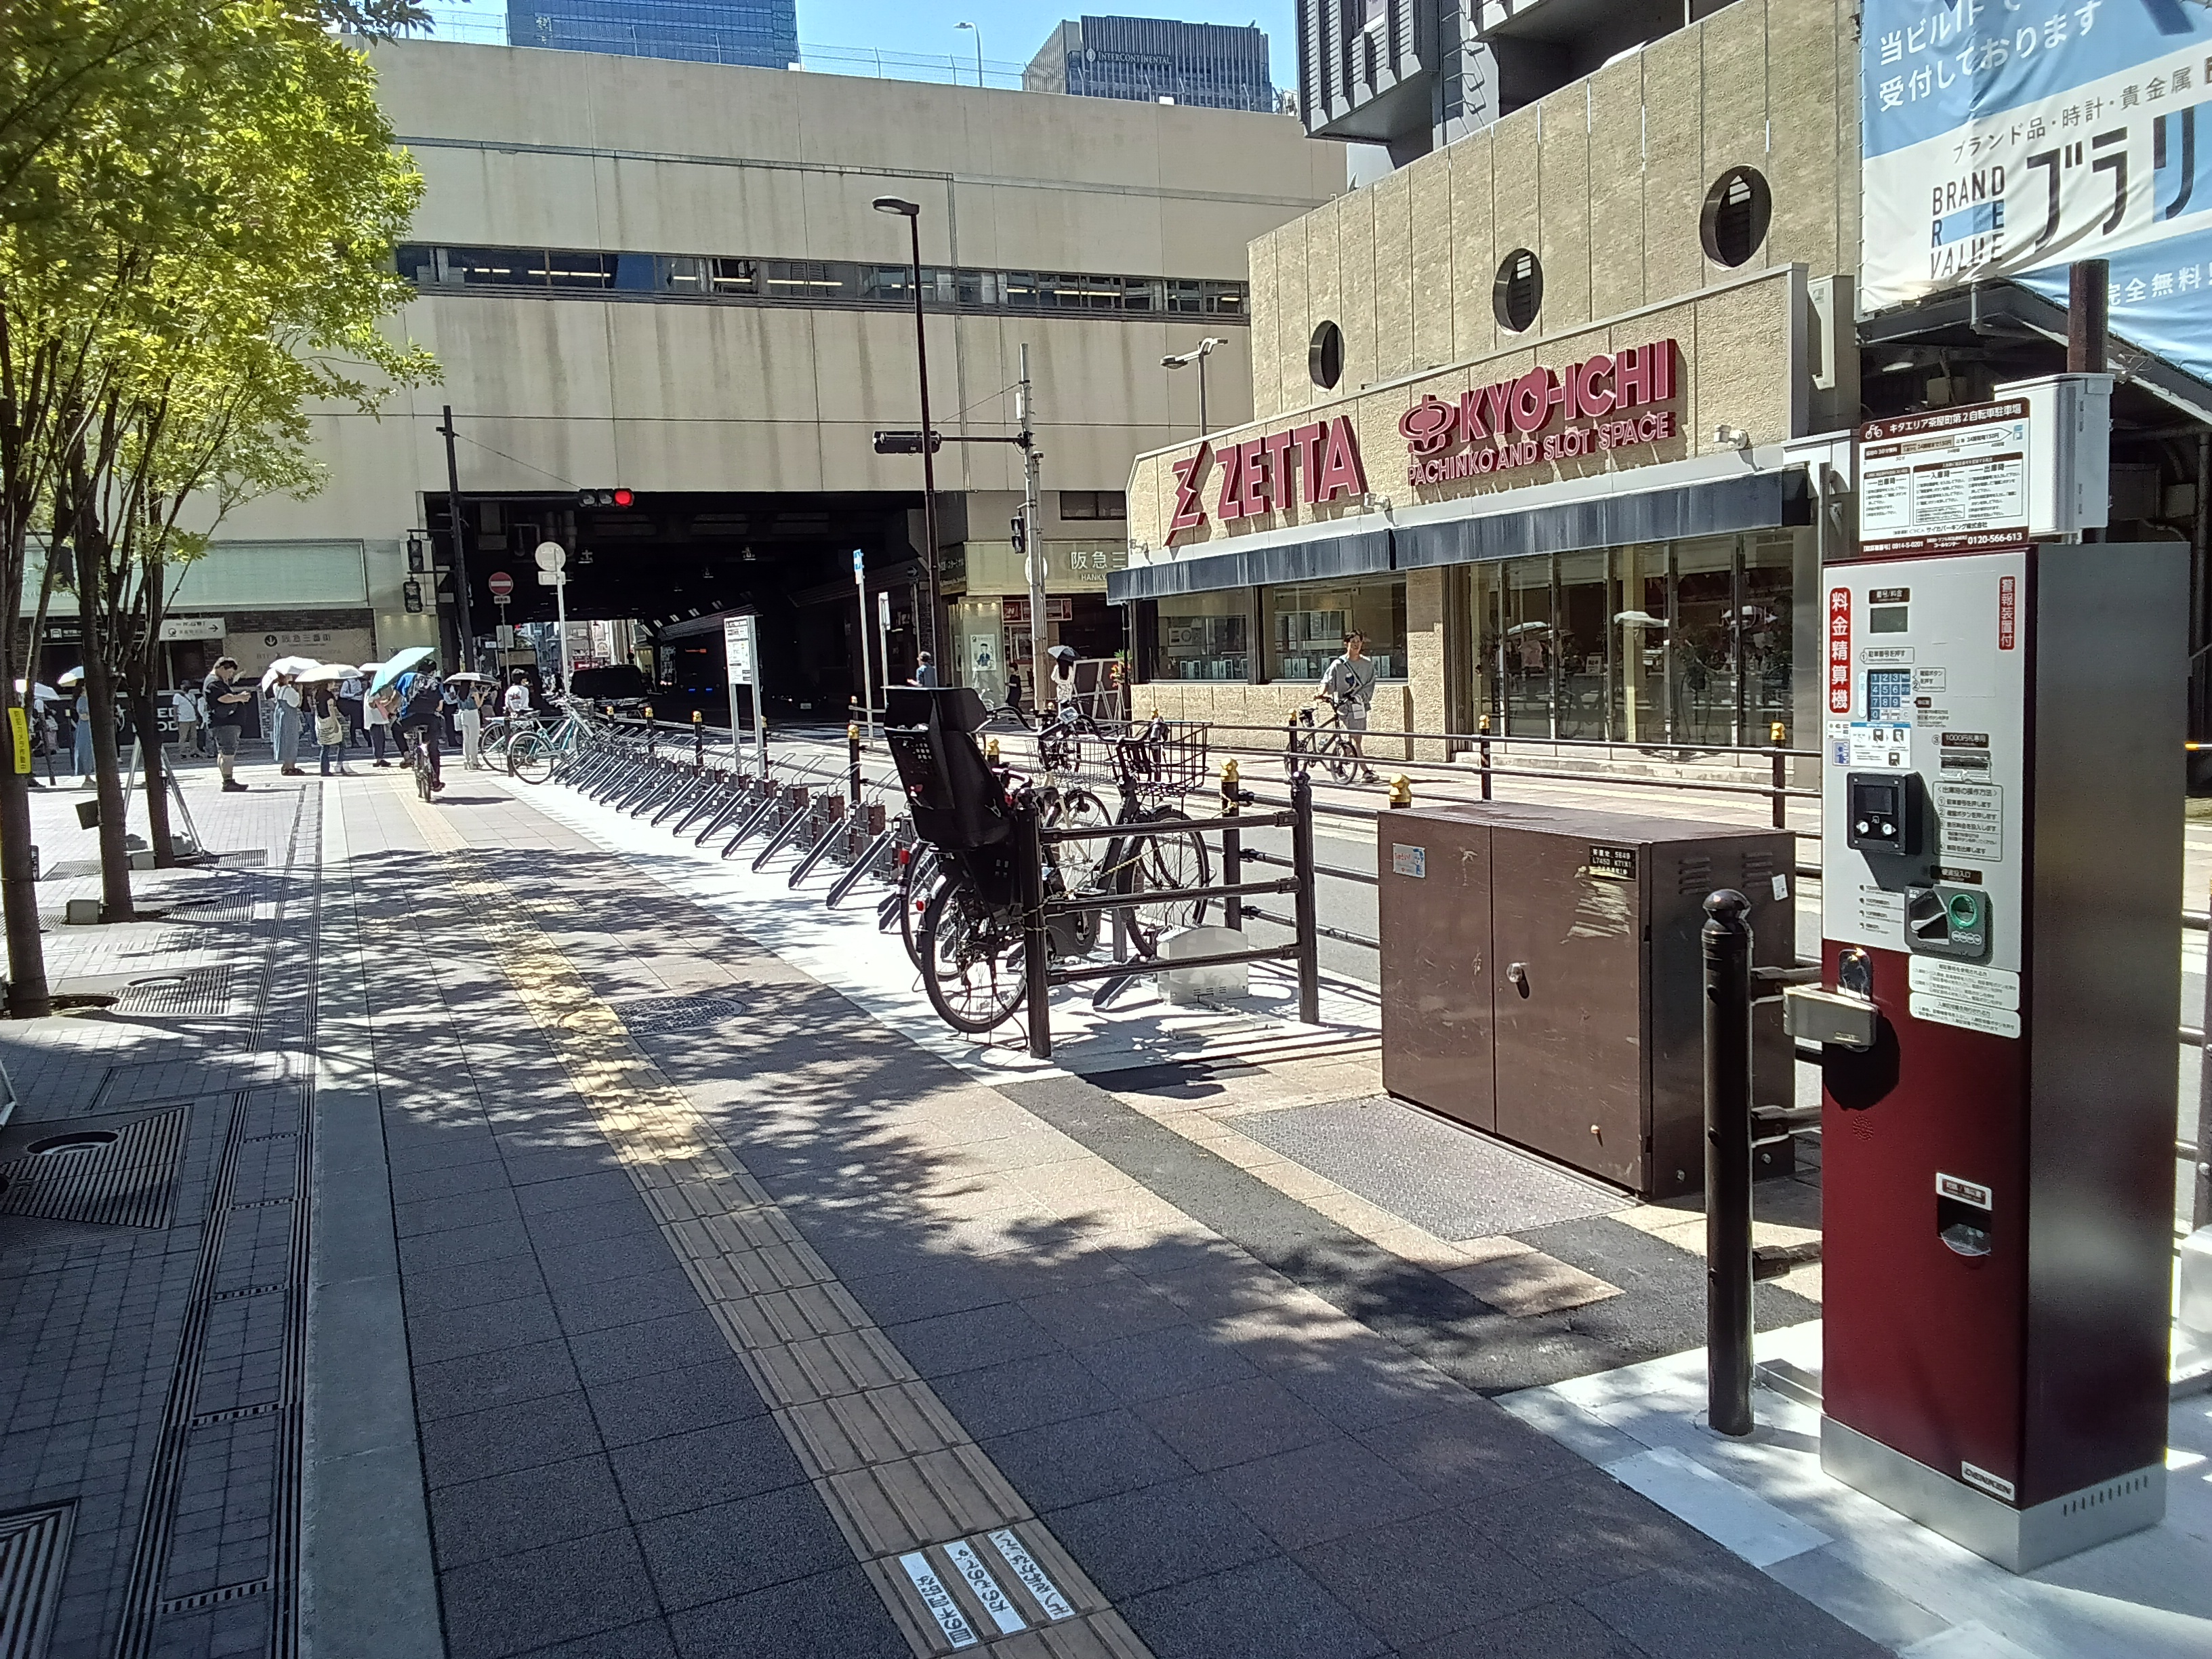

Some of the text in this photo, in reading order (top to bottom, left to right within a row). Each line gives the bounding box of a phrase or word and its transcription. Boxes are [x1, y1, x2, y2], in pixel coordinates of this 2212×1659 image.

[1098, 51, 1172, 64] INTERCONTINENTAL
[1879, 0, 2103, 112] 受付しております
[1932, 165, 2005, 216] BRAND
[1930, 232, 2005, 280] VALUE
[1460, 340, 1673, 444] KYO-ICHI
[1214, 415, 1364, 520] ZETTA
[1407, 411, 1670, 486] PACHINKO AND SLOT SPACE
[1967, 533, 2023, 545] 0120-566-613
[2000, 577, 2014, 649] 警報装置付
[1831, 590, 1849, 710] 料金精算機
[914, 1575, 975, 1643] 目の不自由な
